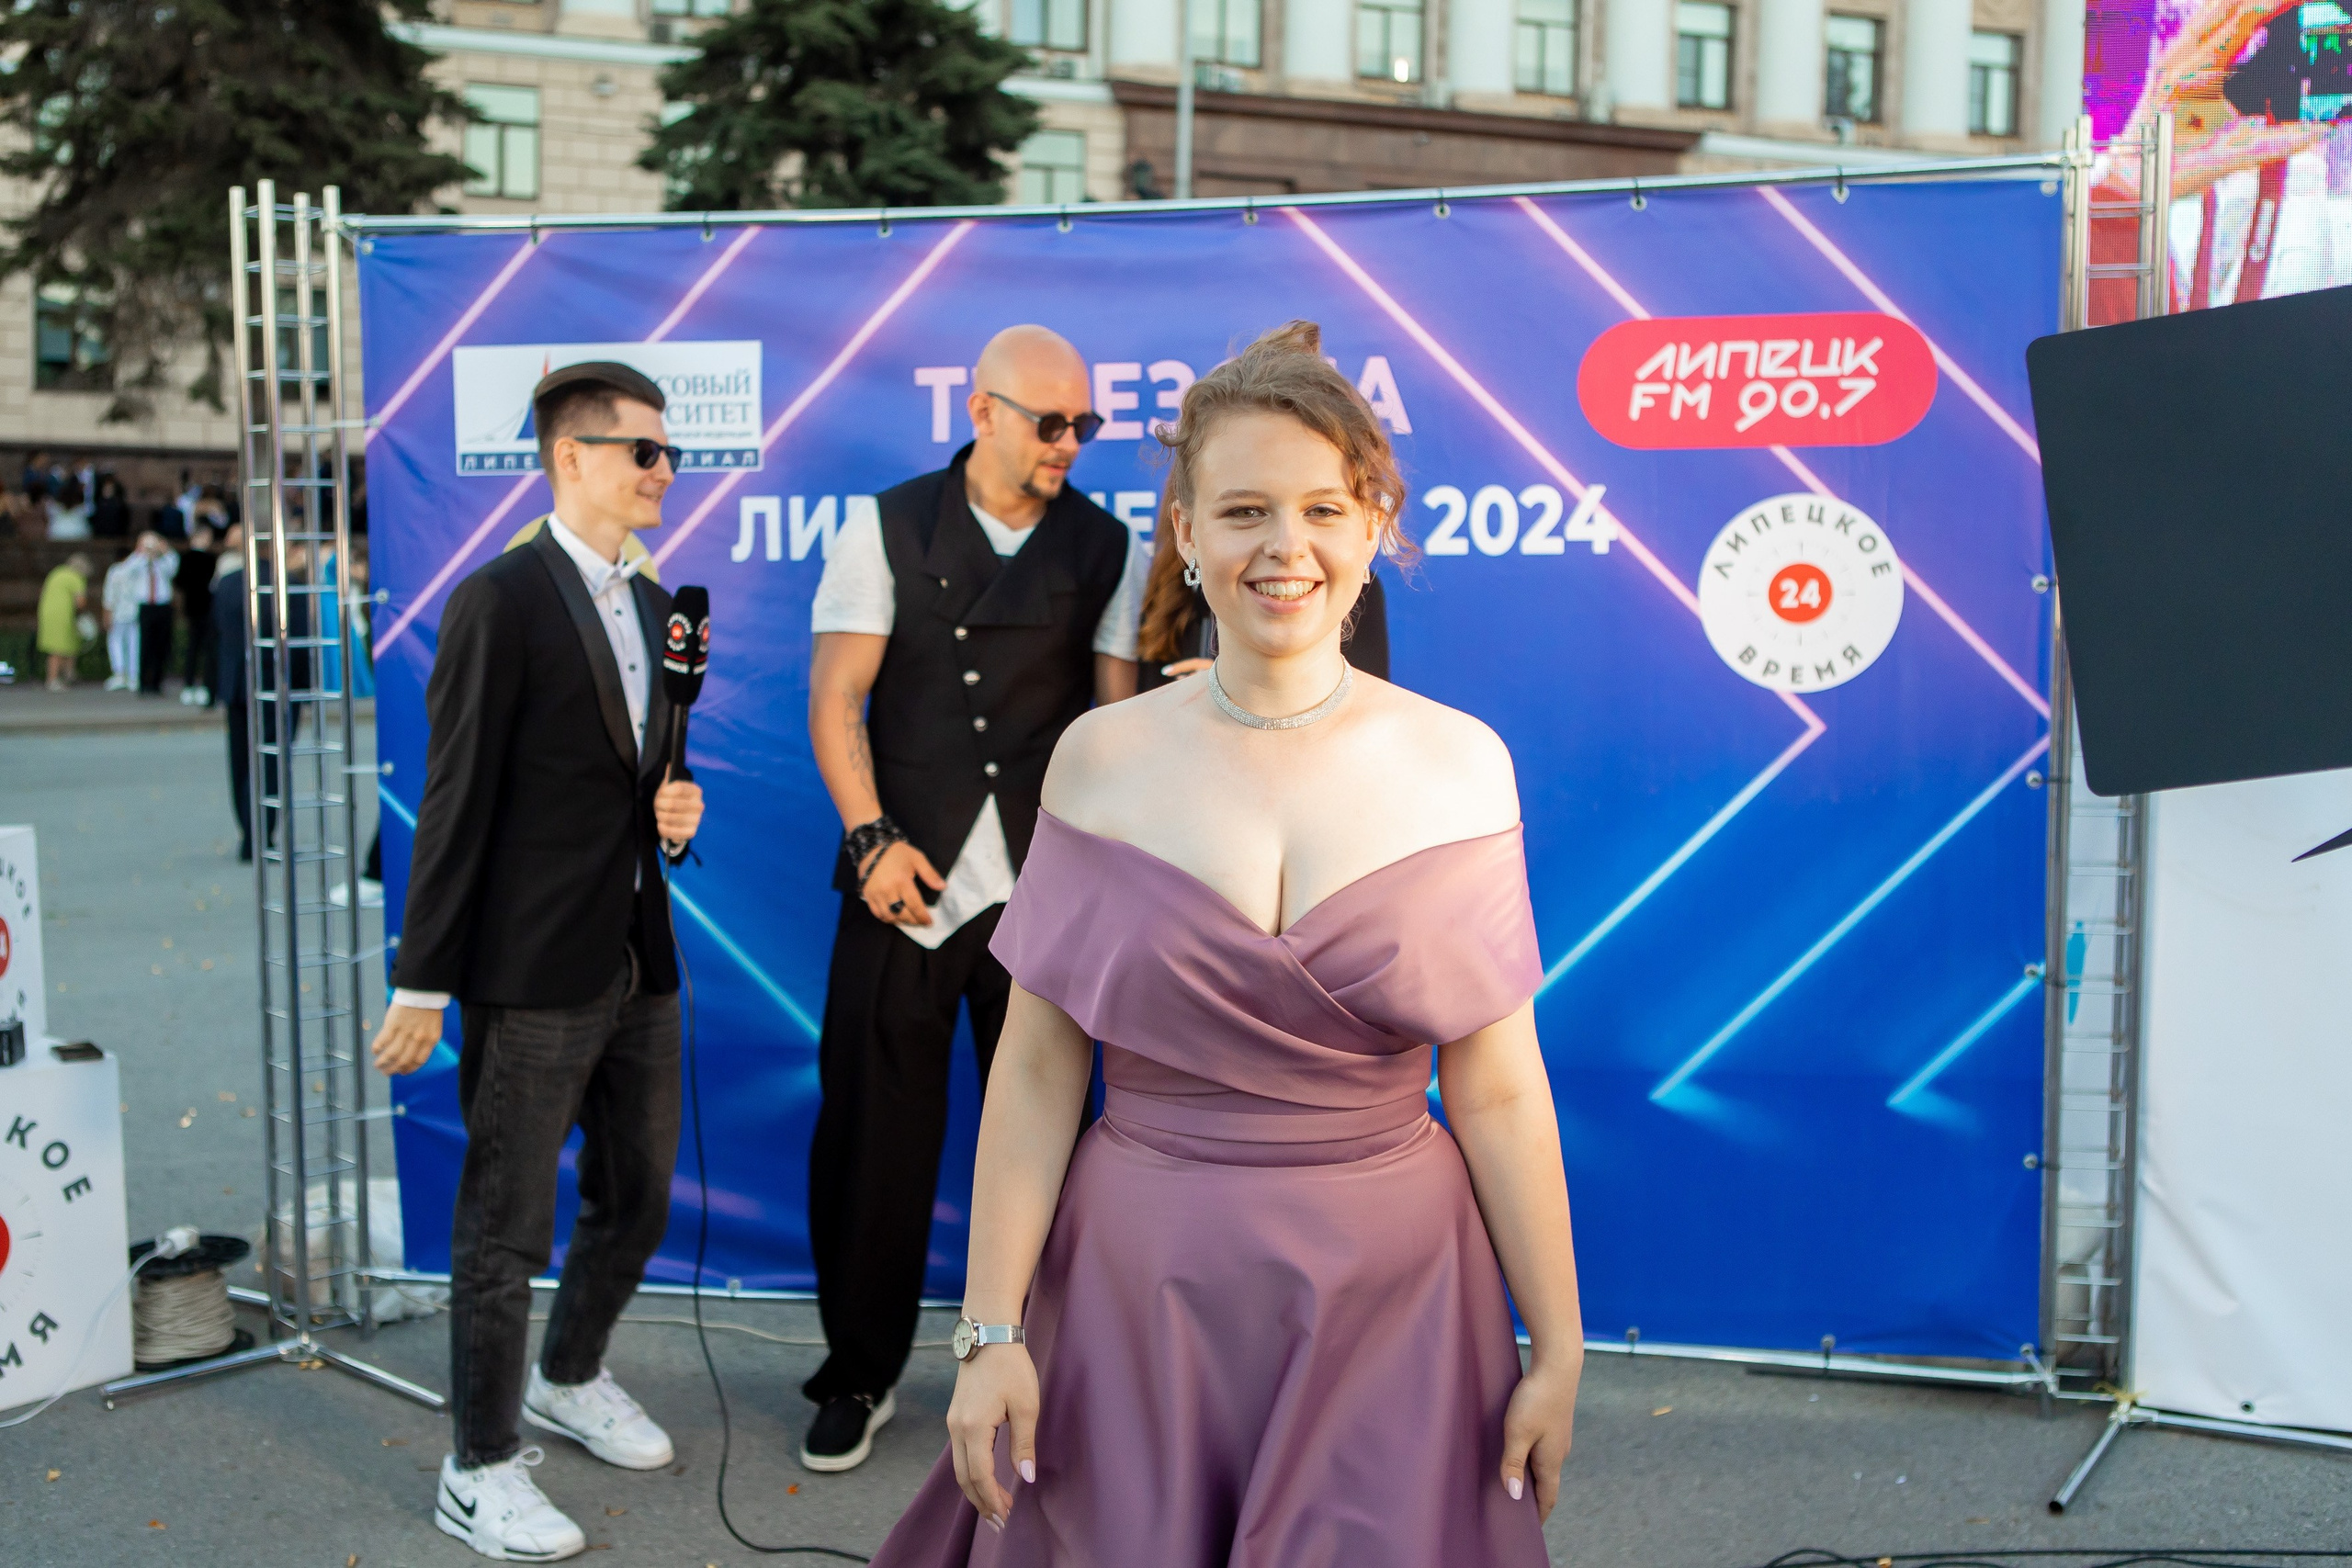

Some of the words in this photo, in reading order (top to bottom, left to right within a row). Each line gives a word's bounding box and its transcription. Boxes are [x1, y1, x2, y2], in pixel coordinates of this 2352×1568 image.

[1635, 336, 1883, 380] ЛИПЕЦК
[655, 368, 752, 398] СОВЫЙ
[1628, 382, 1713, 422] FM
[665, 401, 752, 425] СИТЕТ
[463, 454, 535, 470] ЛИПЕ
[681, 450, 756, 467] ЛИАЛ
[1421, 483, 1619, 557] 2024
[1713, 502, 1893, 581] ЛИПЕЦКОЕ
[1779, 578, 1822, 609] 24
[1736, 644, 1863, 685] ВРЕМЯ
